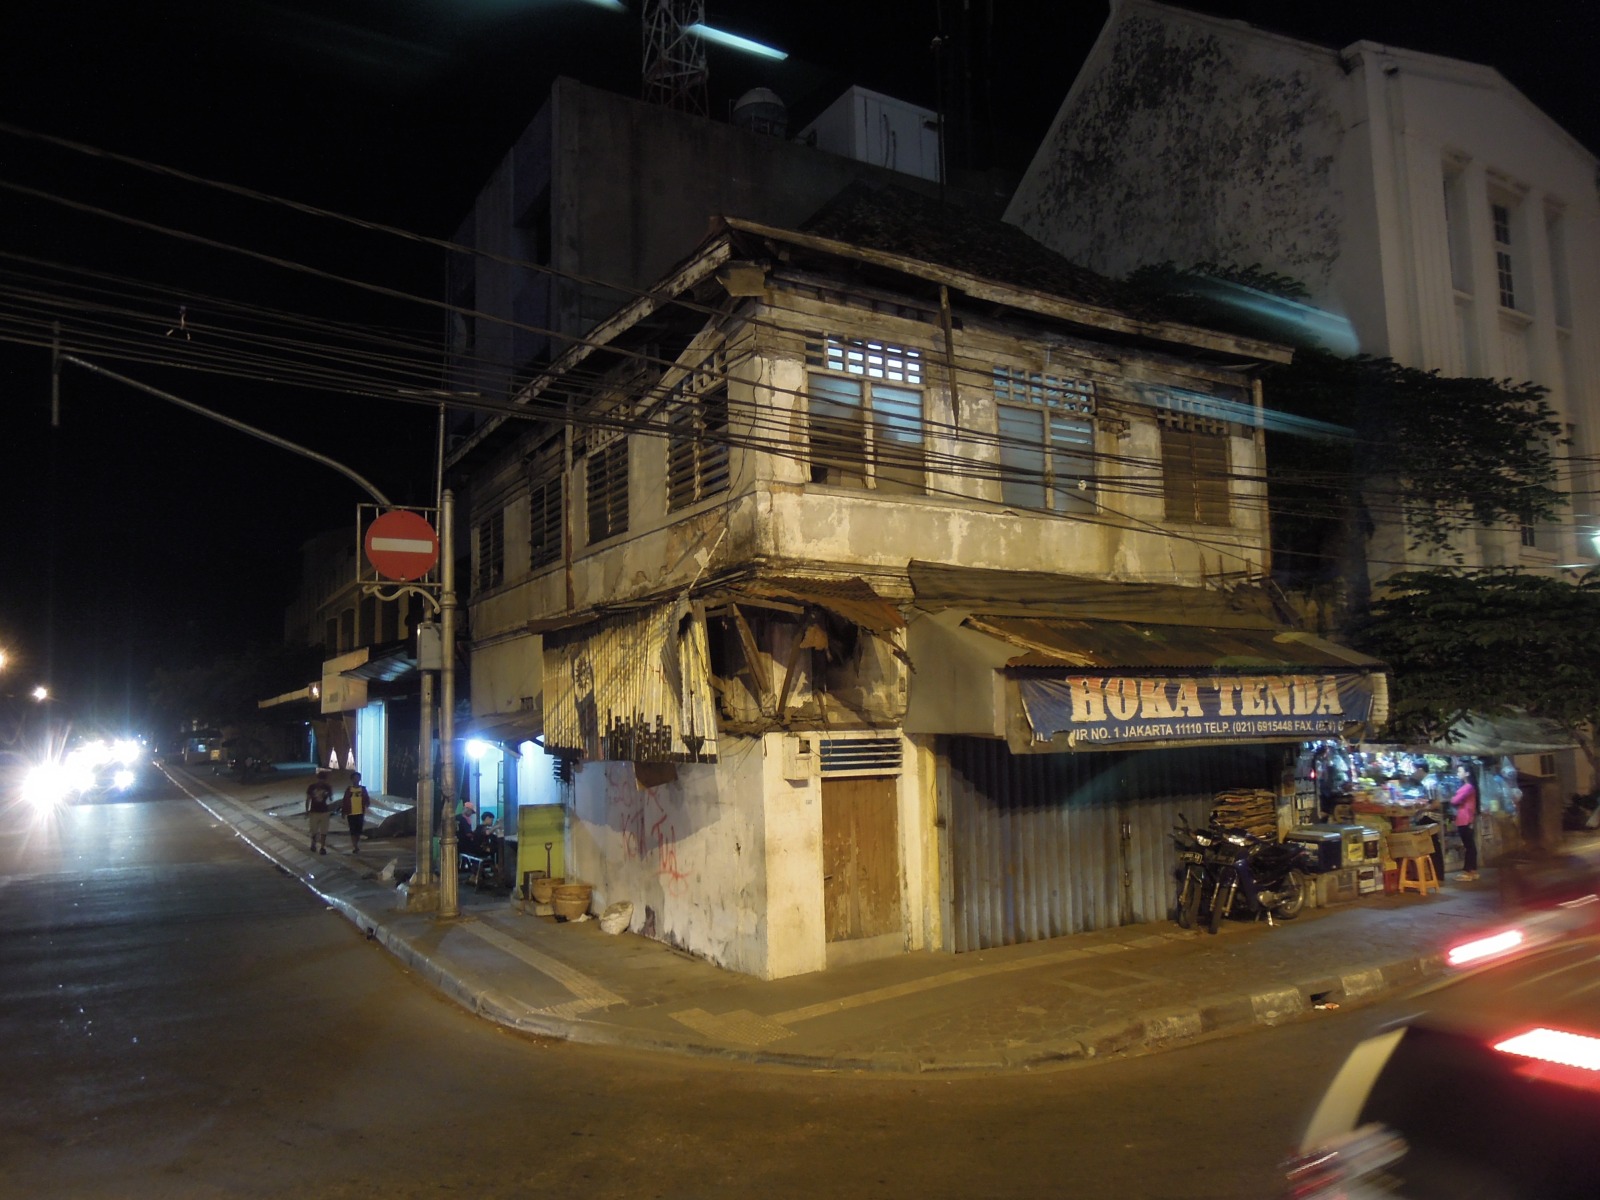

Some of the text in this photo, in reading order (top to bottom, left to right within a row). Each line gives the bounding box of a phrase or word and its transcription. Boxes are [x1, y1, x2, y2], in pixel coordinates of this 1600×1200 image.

[1066, 674, 1344, 722] HOKA TENDA
[1091, 727, 1112, 740] NO.
[1113, 727, 1119, 738] 1
[1122, 724, 1174, 738] JAKARTA
[1176, 722, 1202, 735] 11110
[1204, 721, 1231, 734] TELP.
[1232, 721, 1255, 735] (021)
[1257, 720, 1293, 732] 6915448
[1294, 720, 1314, 732] FAX.
